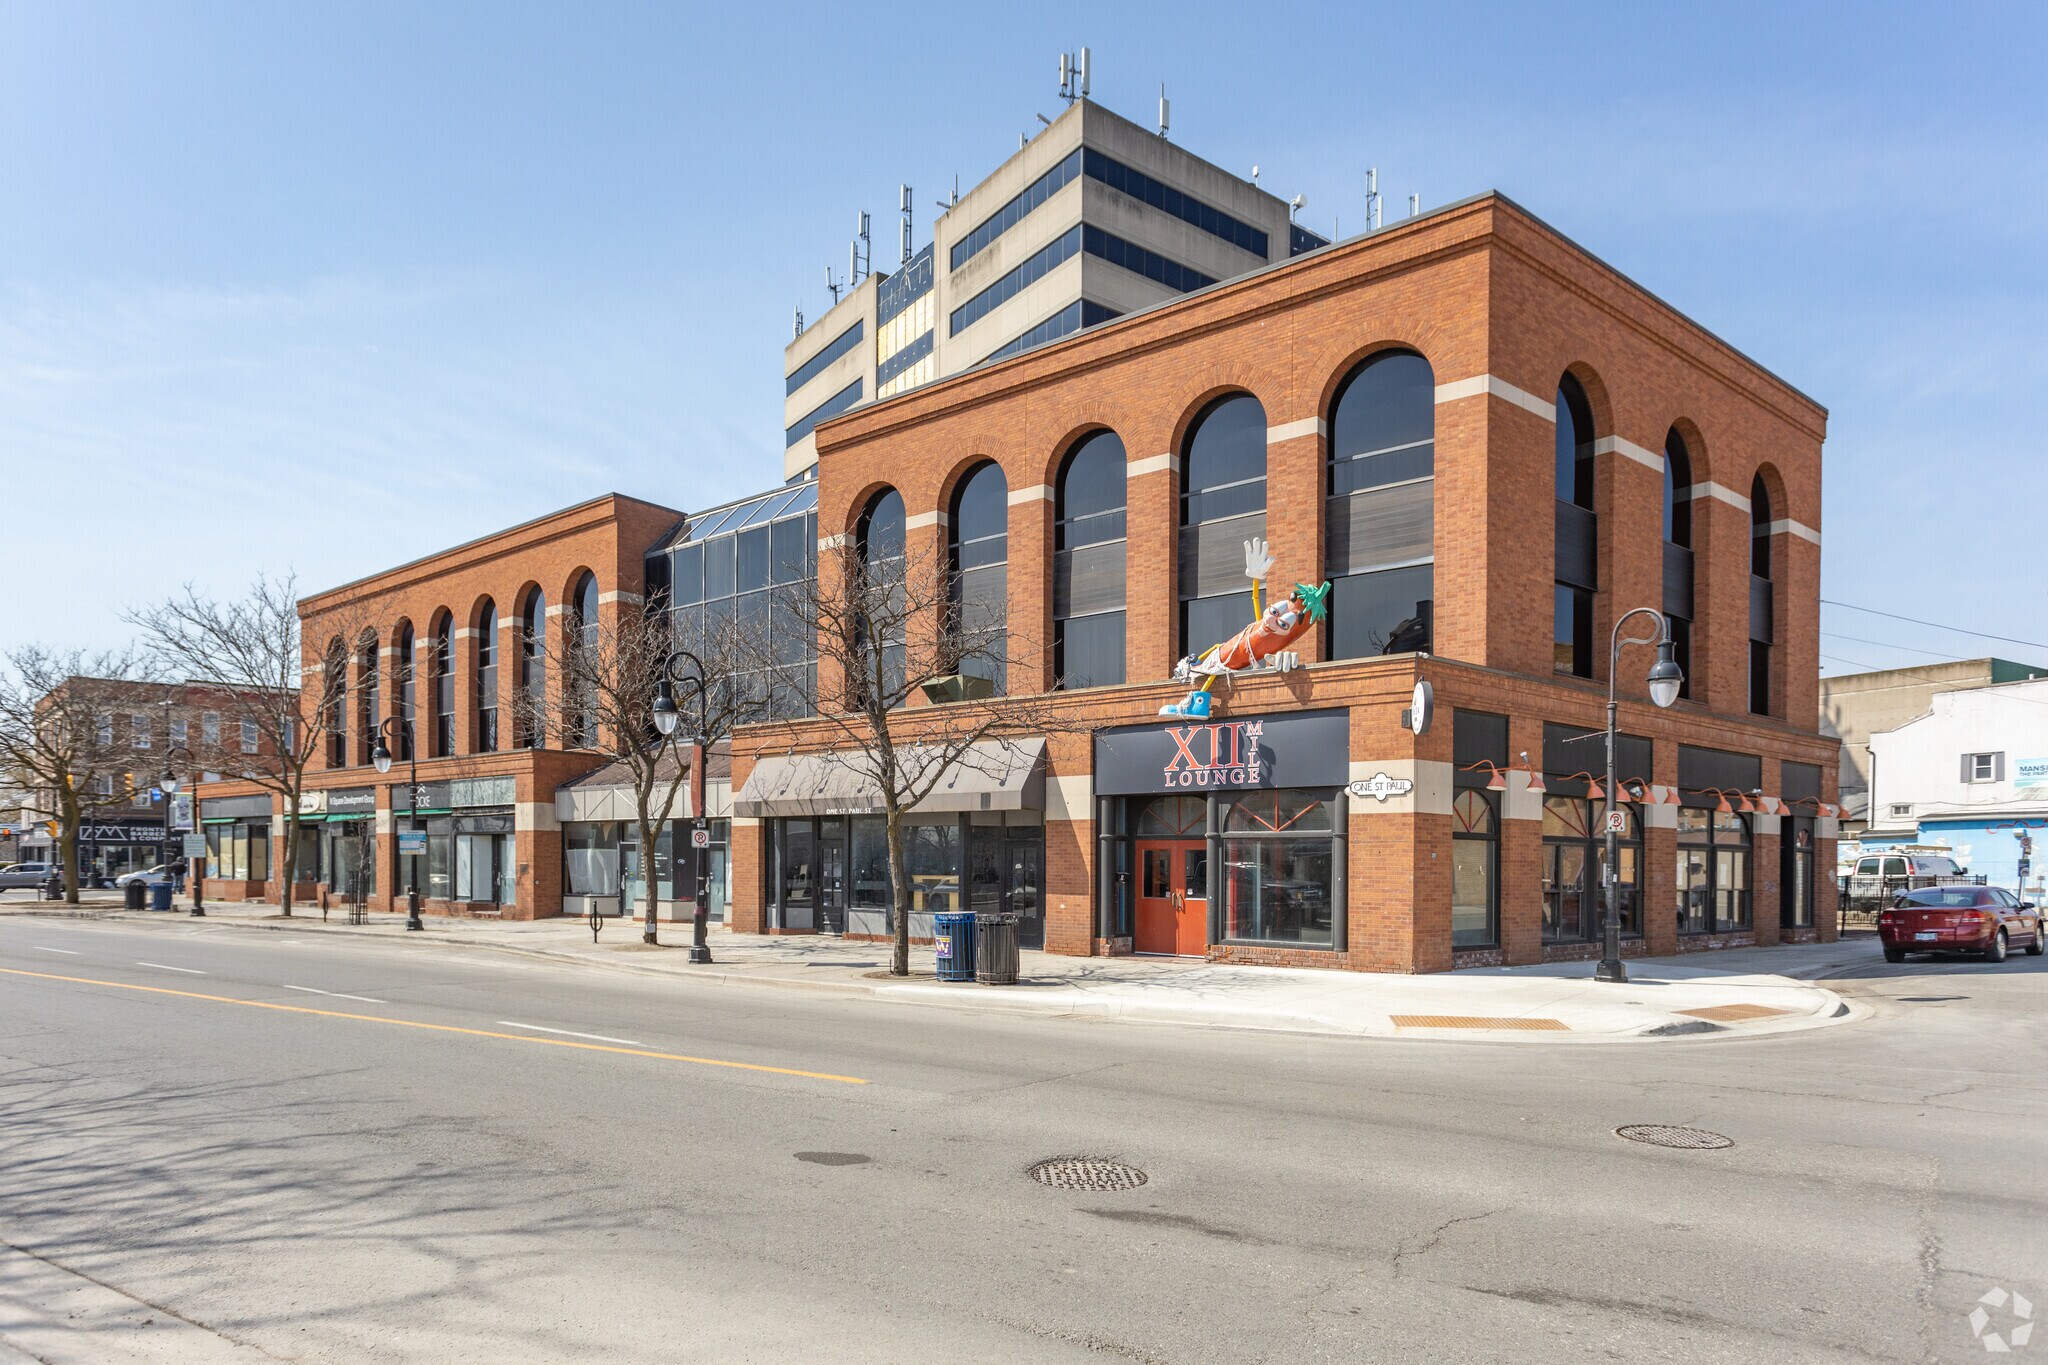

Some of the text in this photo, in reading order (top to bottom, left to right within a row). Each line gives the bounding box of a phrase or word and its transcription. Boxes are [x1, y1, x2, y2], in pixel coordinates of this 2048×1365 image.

[1164, 720, 1263, 784] XII MILE
[1164, 768, 1261, 787] LOUNGE
[1353, 781, 1408, 792] ONE ST PAUL
[344, 796, 364, 805] Development
[364, 794, 374, 804] Group
